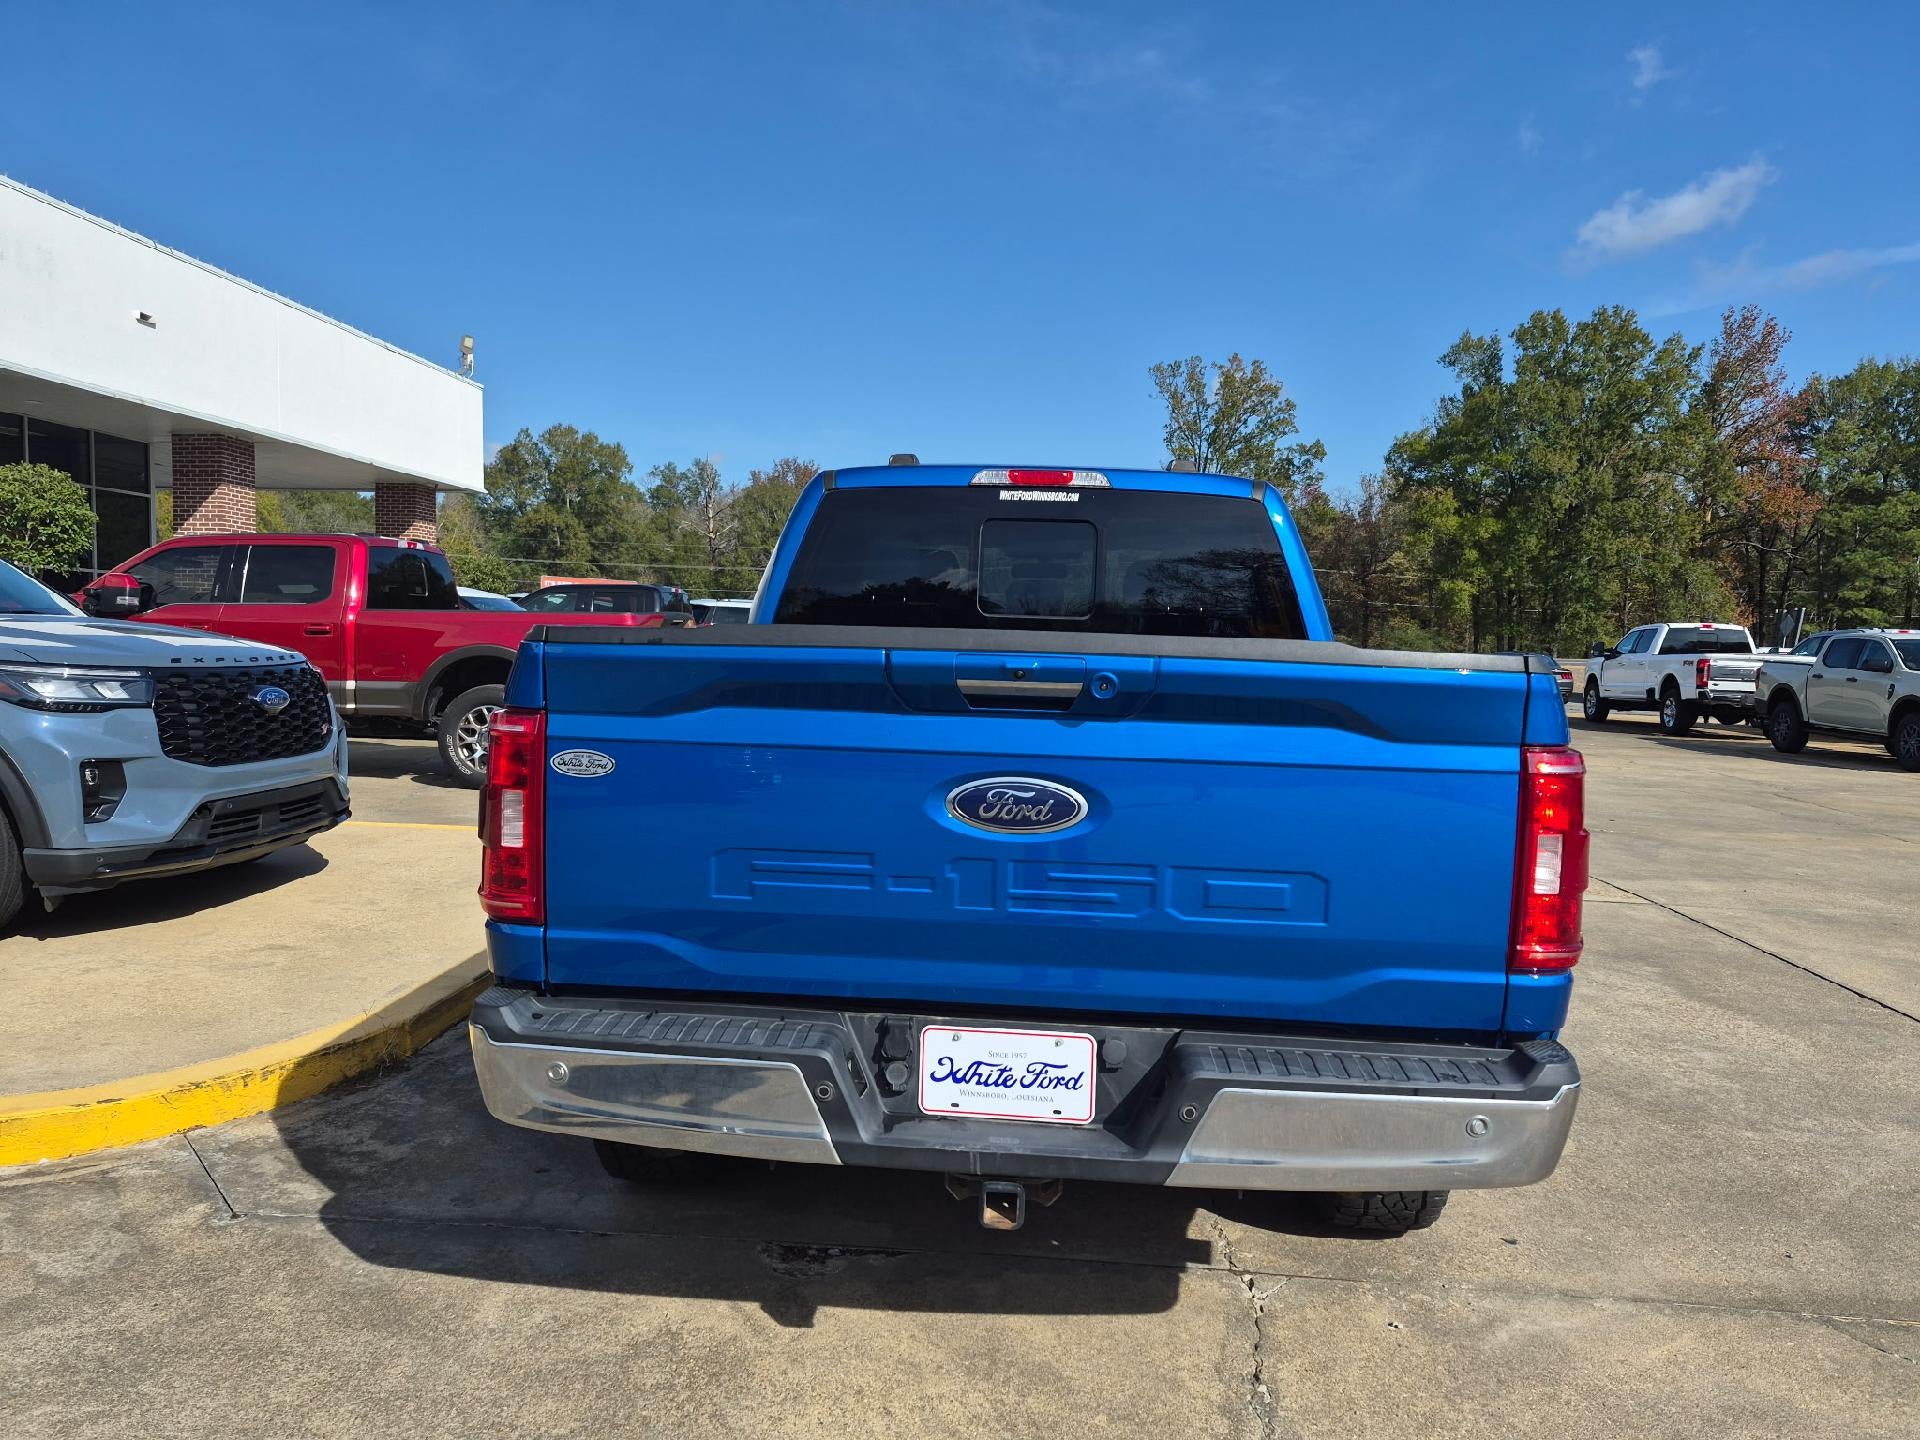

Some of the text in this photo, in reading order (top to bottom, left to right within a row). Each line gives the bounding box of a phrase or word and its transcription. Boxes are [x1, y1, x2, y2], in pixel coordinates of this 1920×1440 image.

[170, 654, 296, 664] EXPLORER
[557, 757, 583, 767] White
[585, 758, 609, 770] Ford
[978, 788, 1055, 821] Ford
[709, 847, 1330, 927] F-150
[929, 1056, 1085, 1091] White Ford
